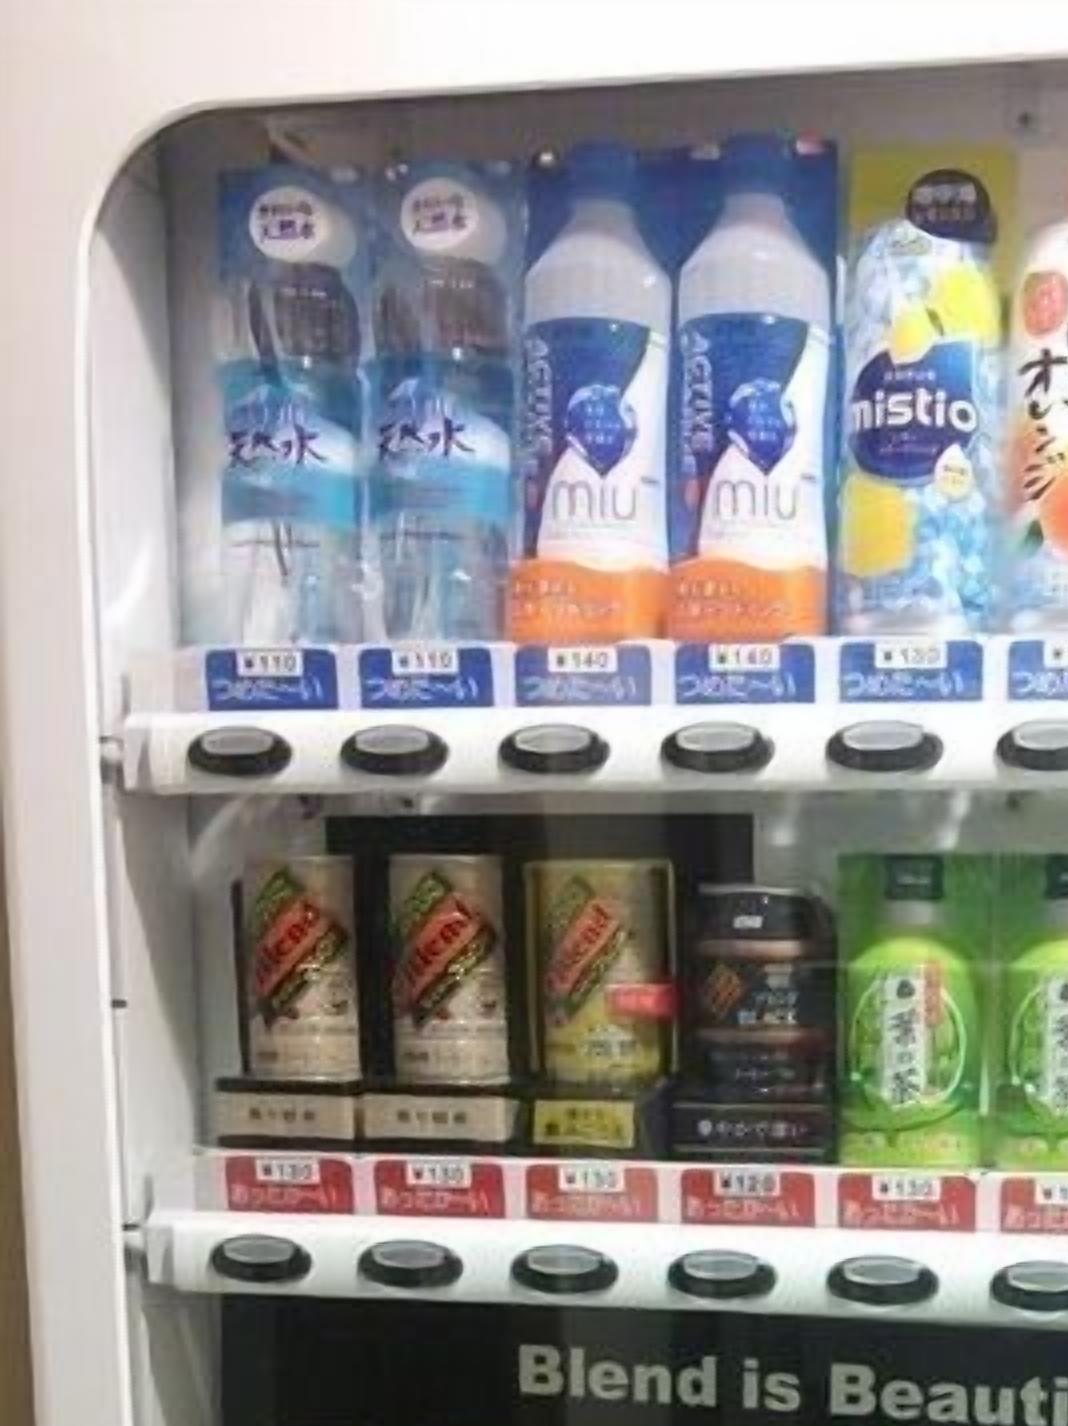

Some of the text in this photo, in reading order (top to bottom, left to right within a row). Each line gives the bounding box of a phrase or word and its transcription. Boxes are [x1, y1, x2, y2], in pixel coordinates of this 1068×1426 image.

[552, 479, 638, 521] miu
[715, 477, 798, 521] miu
[518, 1344, 718, 1407] Blend
[742, 1358, 801, 1412] is
